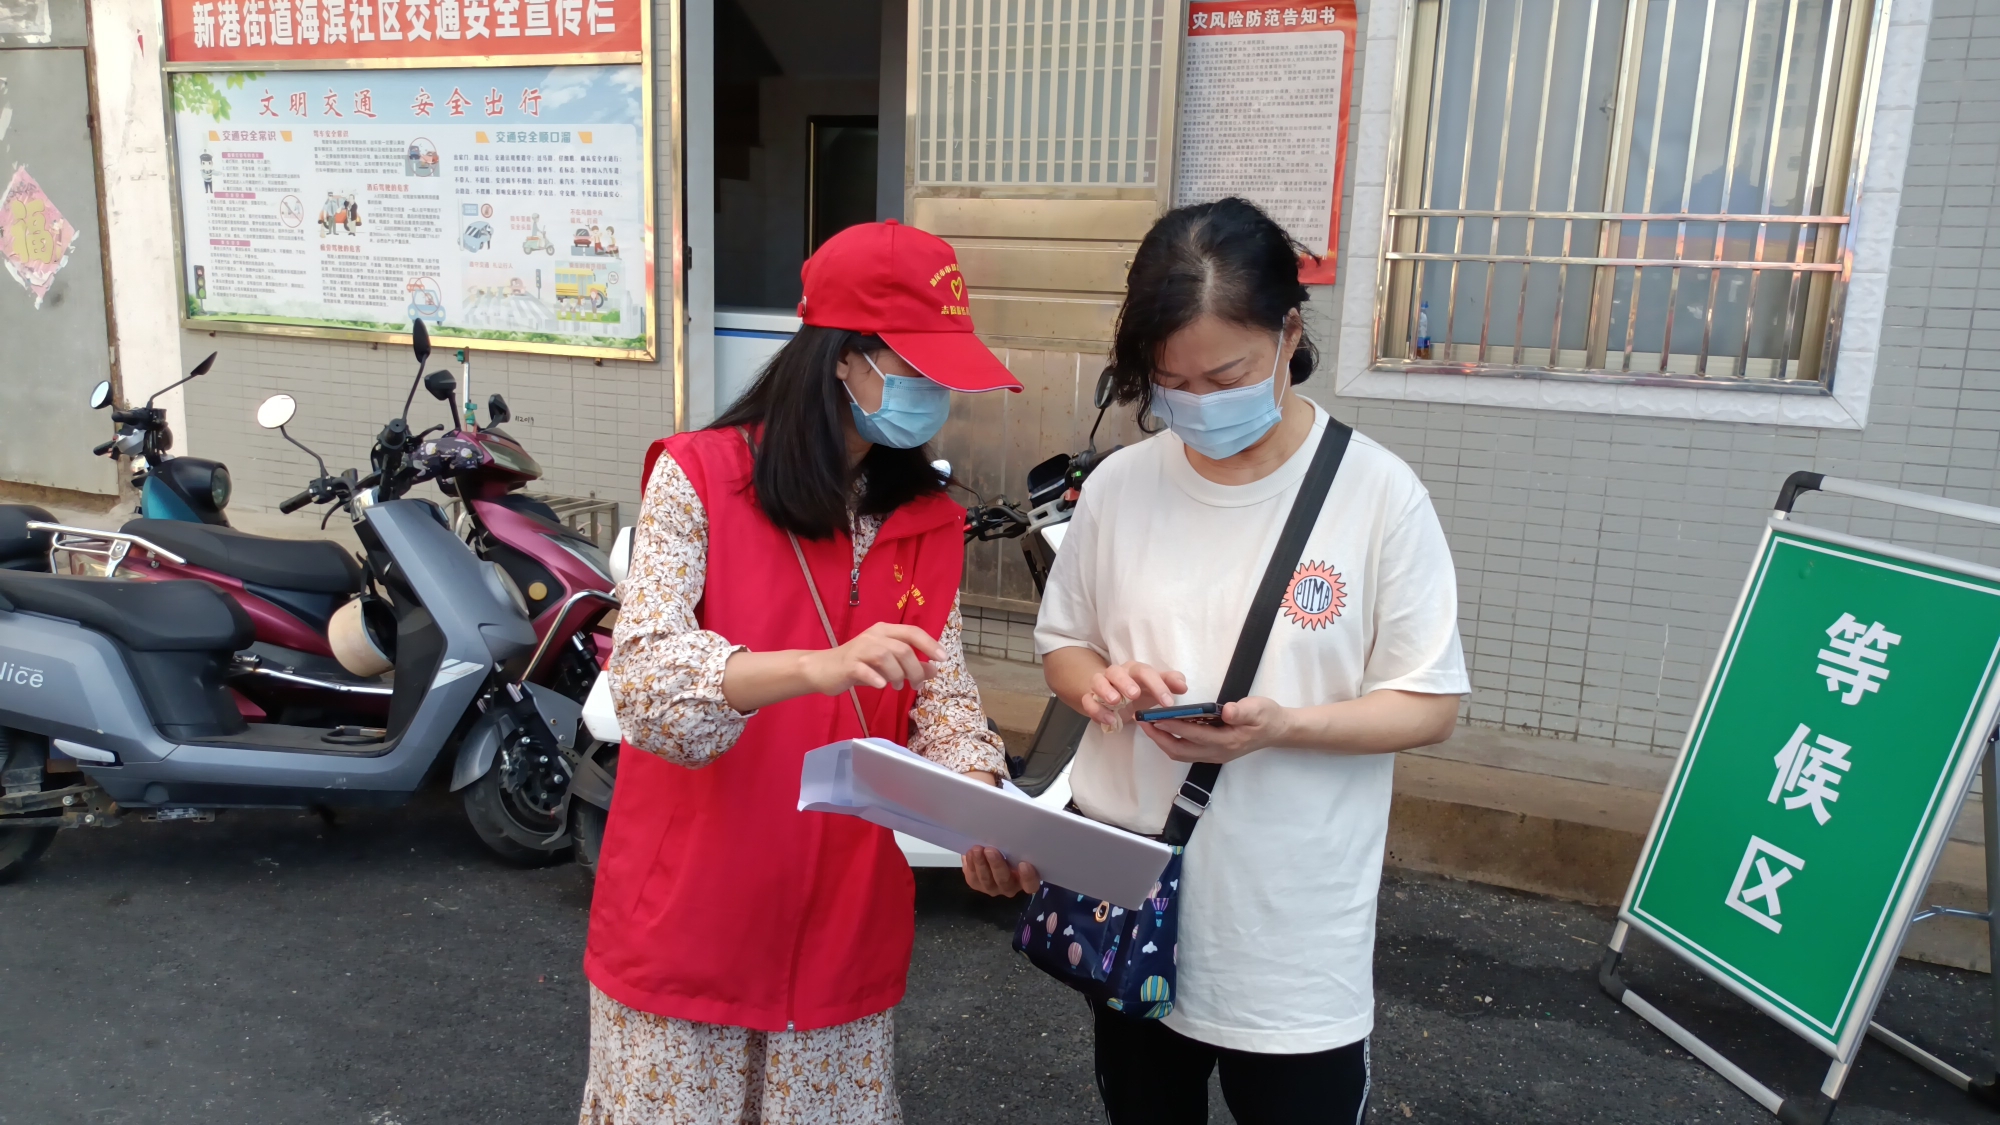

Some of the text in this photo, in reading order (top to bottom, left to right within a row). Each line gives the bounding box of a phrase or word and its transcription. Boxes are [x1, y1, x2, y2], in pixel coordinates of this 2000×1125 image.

[192, 0, 616, 49] 新港街道海滨社区交通安全宣传栏
[1188, 6, 1336, 30] 灾风险防范告知书
[258, 86, 542, 119] 文明交通 安全出行
[222, 130, 277, 142] 交通安全常识
[313, 130, 349, 138] 驾车安全常识
[495, 131, 571, 143] 交通安全顺口溜
[366, 183, 409, 192] 酒后驾驶的危害
[1295, 578, 1330, 611] PUMA
[1724, 611, 1902, 935] 等候区
